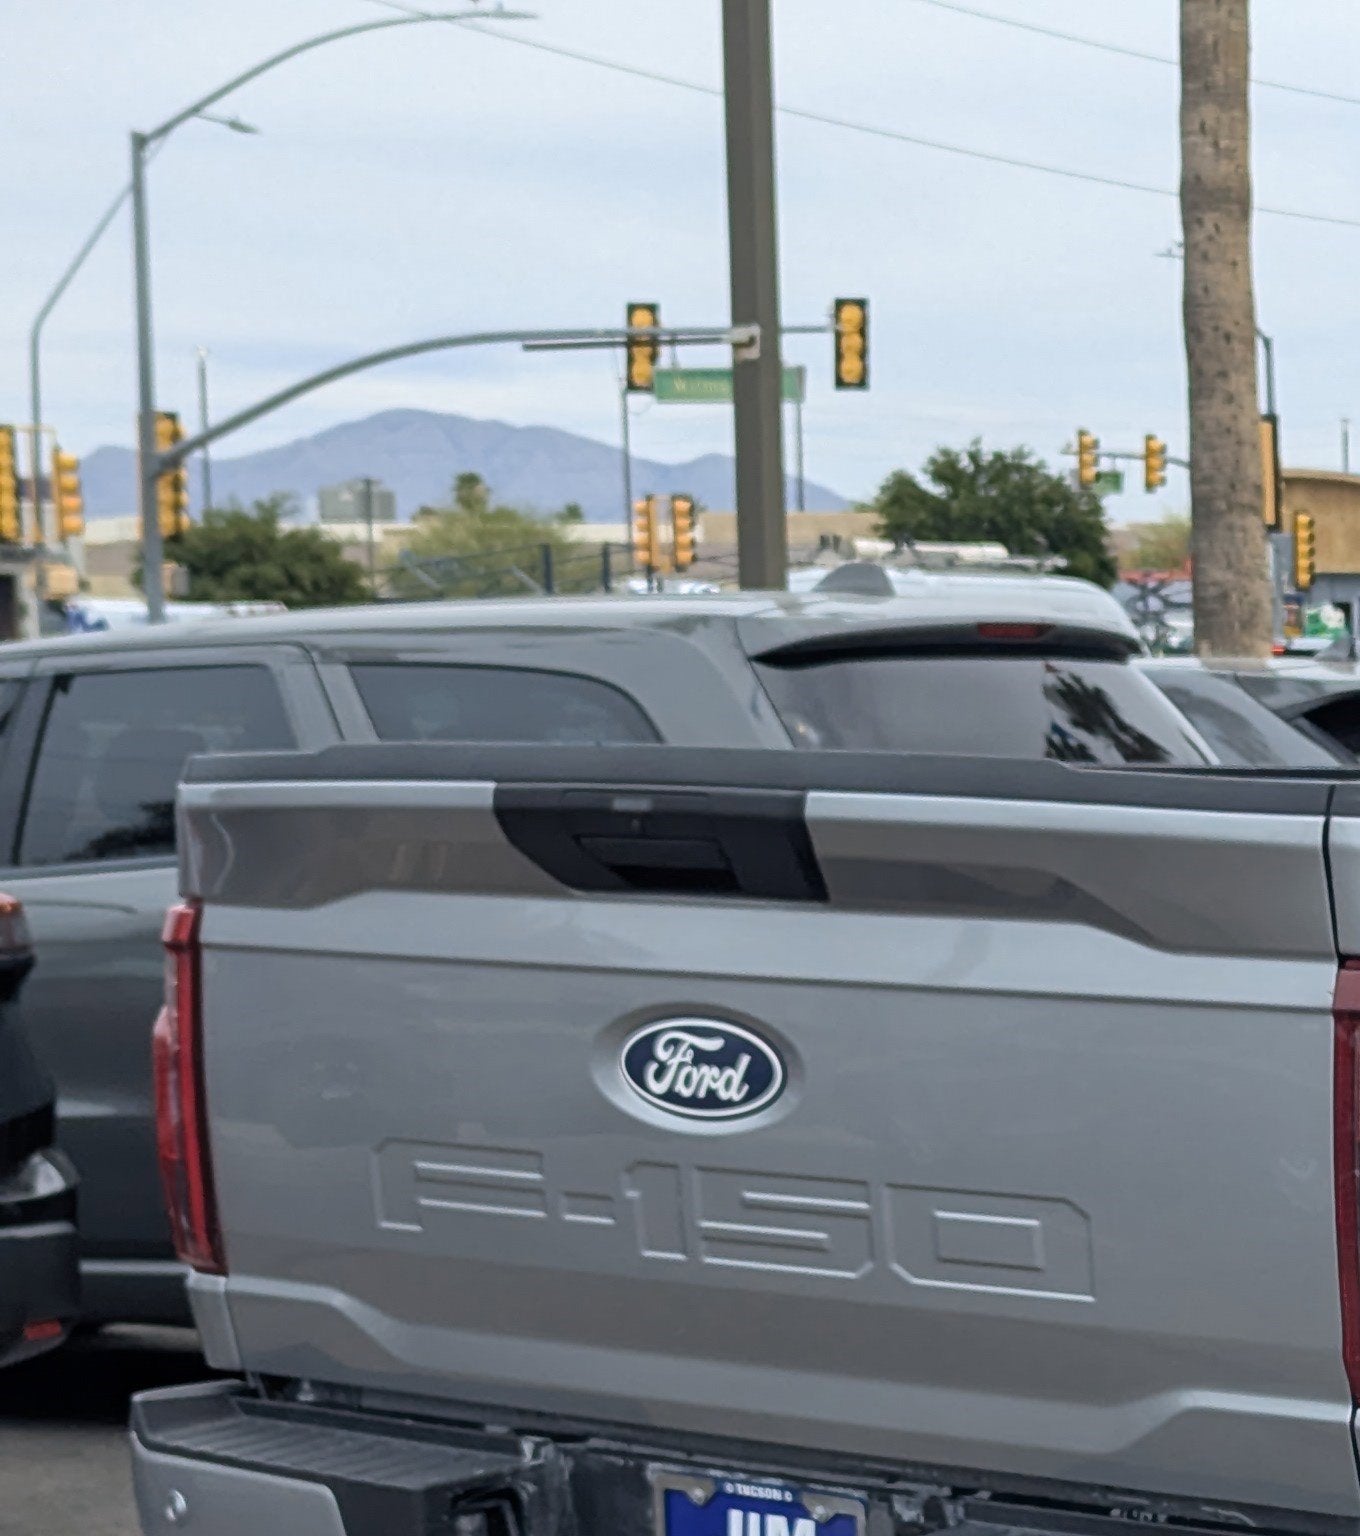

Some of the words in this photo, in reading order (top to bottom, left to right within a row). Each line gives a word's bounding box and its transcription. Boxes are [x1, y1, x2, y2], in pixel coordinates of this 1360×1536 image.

[644, 1029, 751, 1103] Ford
[371, 1136, 1096, 1302] F-150
[736, 1483, 783, 1502] TUCSON
